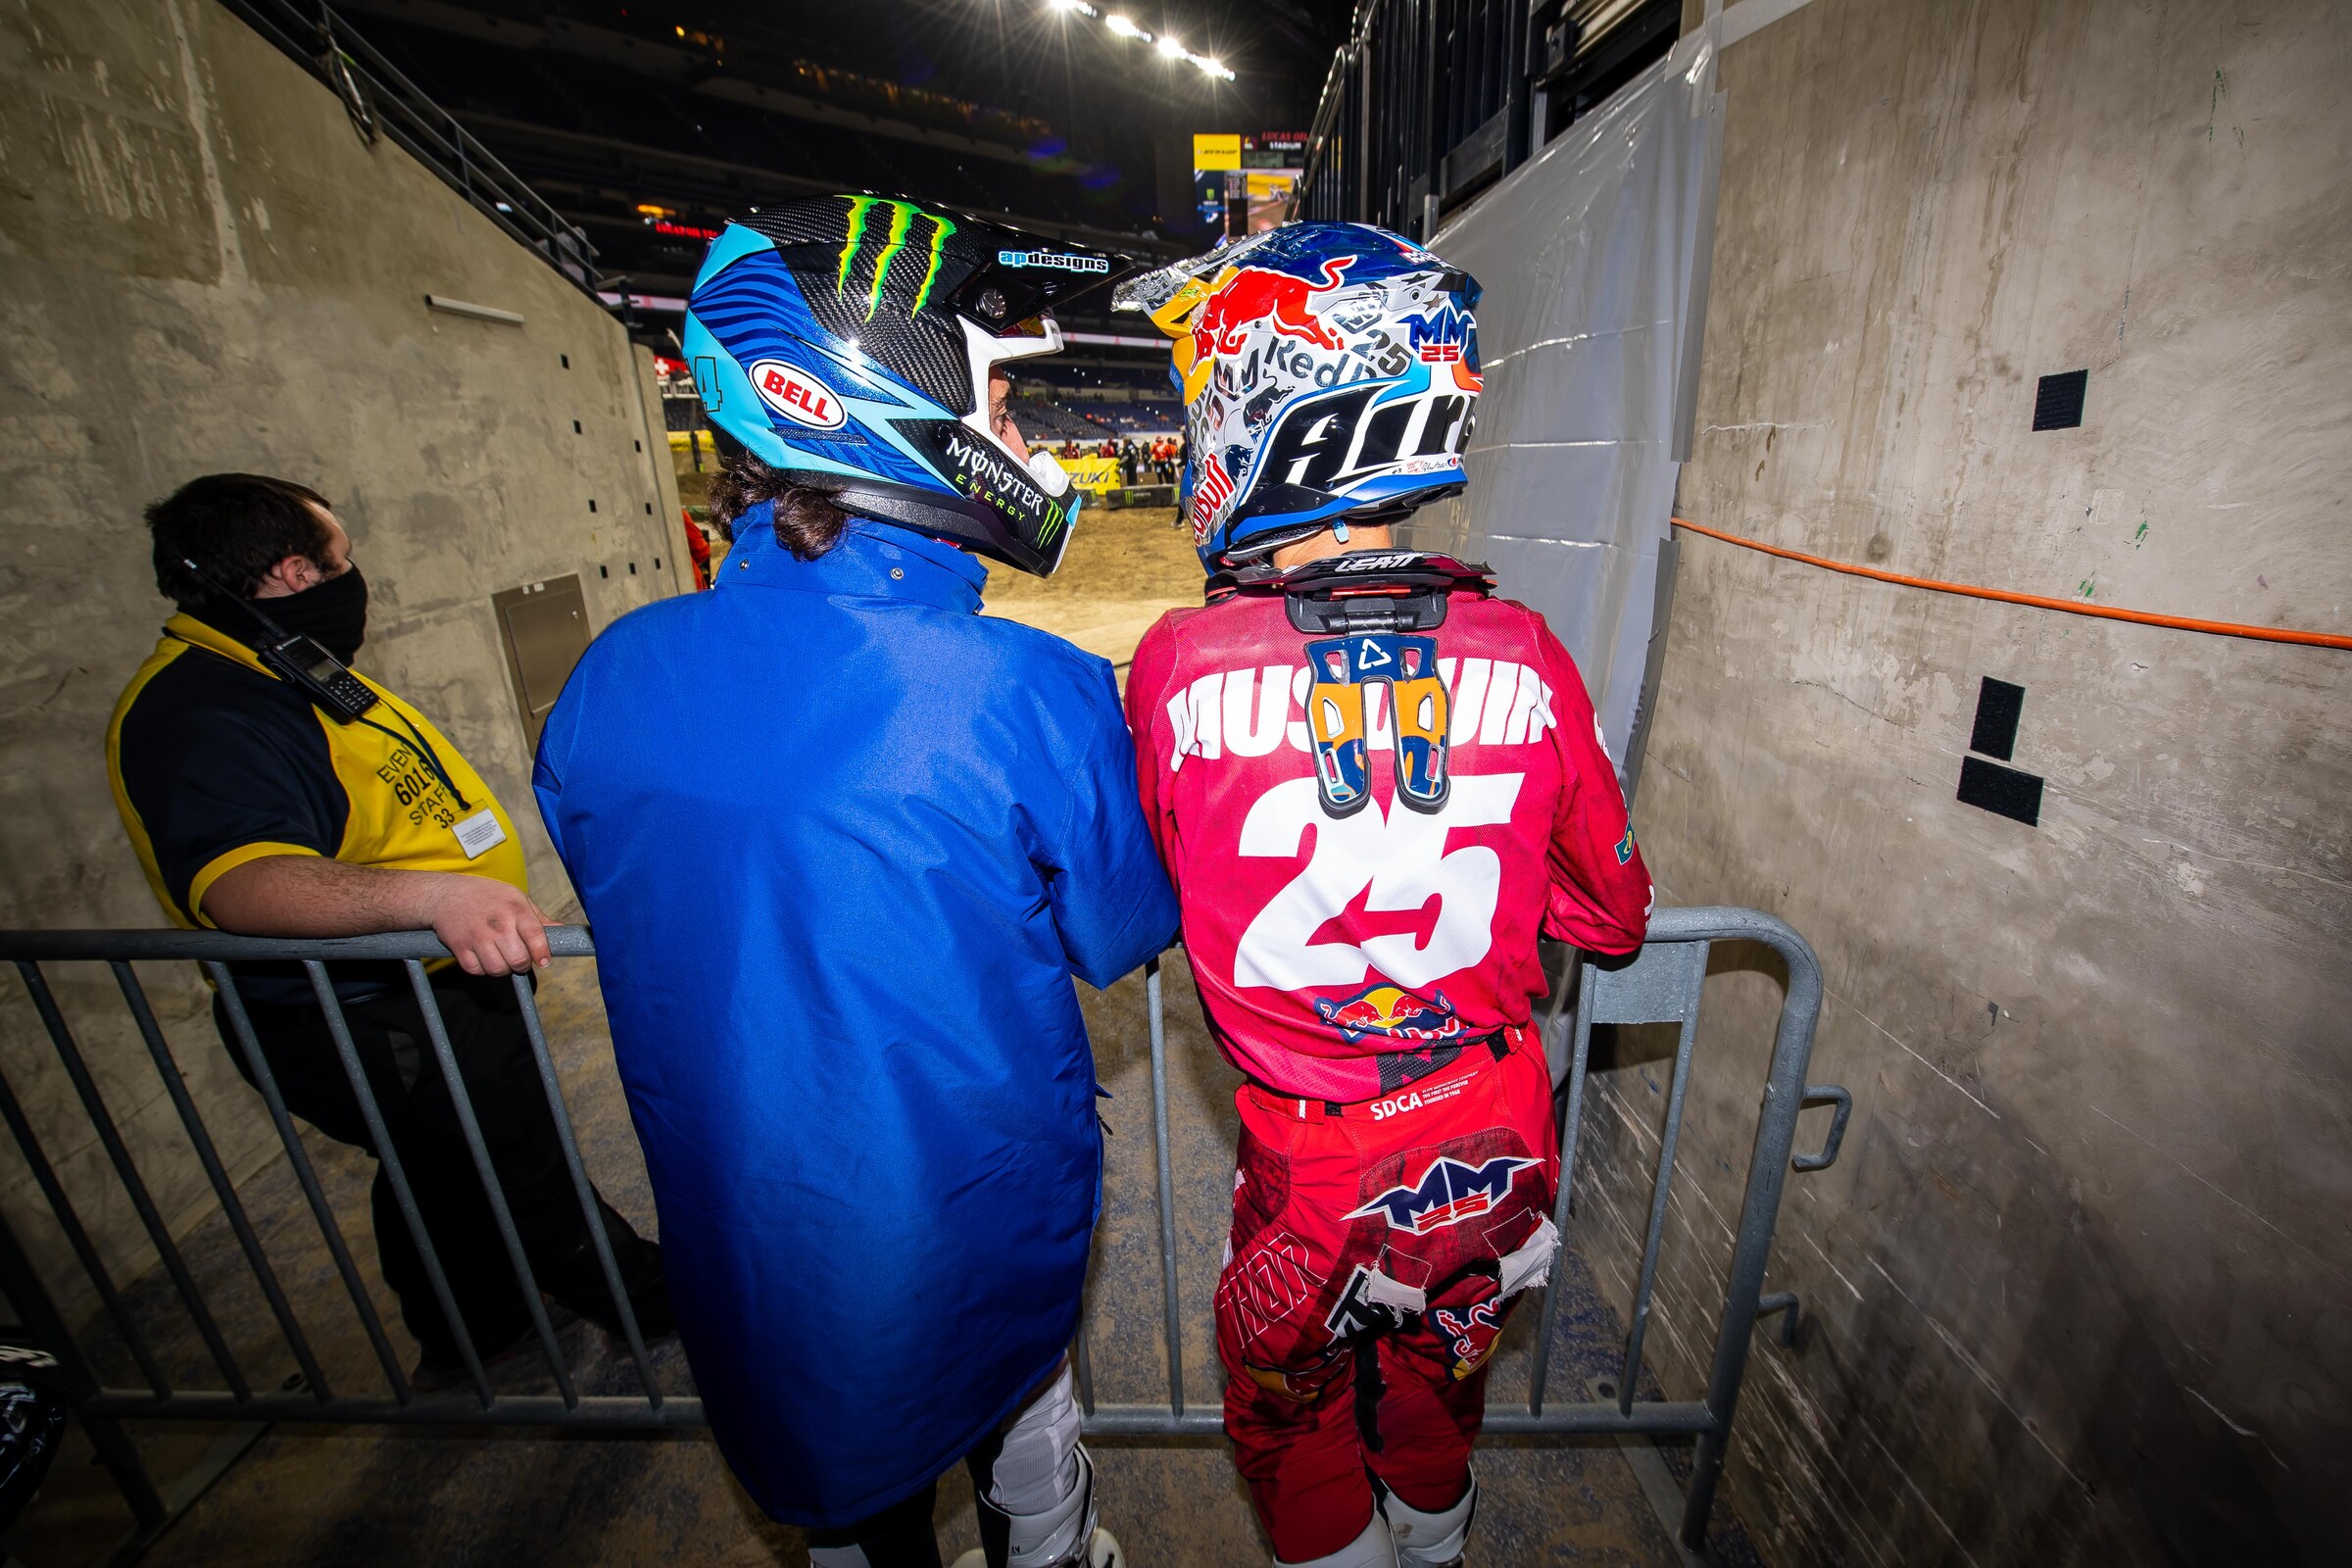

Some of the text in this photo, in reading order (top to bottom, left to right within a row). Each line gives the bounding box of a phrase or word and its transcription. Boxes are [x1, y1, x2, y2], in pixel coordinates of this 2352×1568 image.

[999, 251, 1108, 273] apdesigns
[1421, 345, 1459, 363] 25
[687, 357, 723, 412] 4
[762, 368, 829, 422] BELL
[946, 437, 1044, 516] MONSTER
[1066, 471, 1109, 484] ZUKI
[956, 472, 1025, 521] ENERGY
[1335, 553, 1424, 572] LEATT
[376, 743, 413, 784] EVEN
[433, 808, 456, 829] 33
[1234, 772, 1526, 992] 25
[1370, 1092, 1423, 1121] SDCA
[1414, 1192, 1490, 1231] 25
